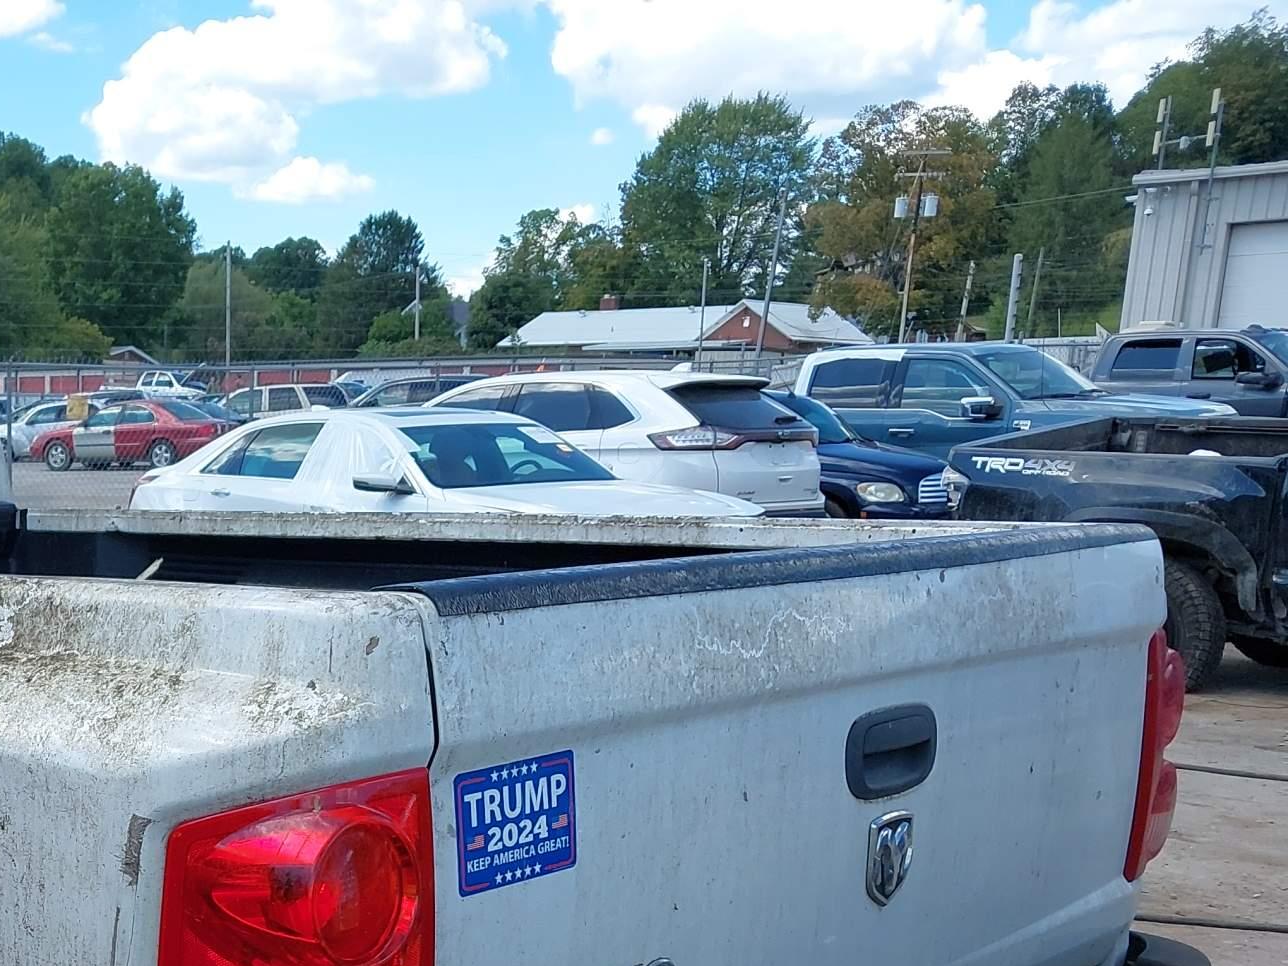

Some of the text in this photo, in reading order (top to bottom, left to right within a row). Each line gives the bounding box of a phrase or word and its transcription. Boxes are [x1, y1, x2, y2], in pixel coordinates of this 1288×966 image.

[972, 456, 1024, 473] TRD
[463, 773, 567, 828] TRUMP
[487, 814, 549, 853] 2024
[467, 835, 570, 873] KEEP AMERICA GREAT!
